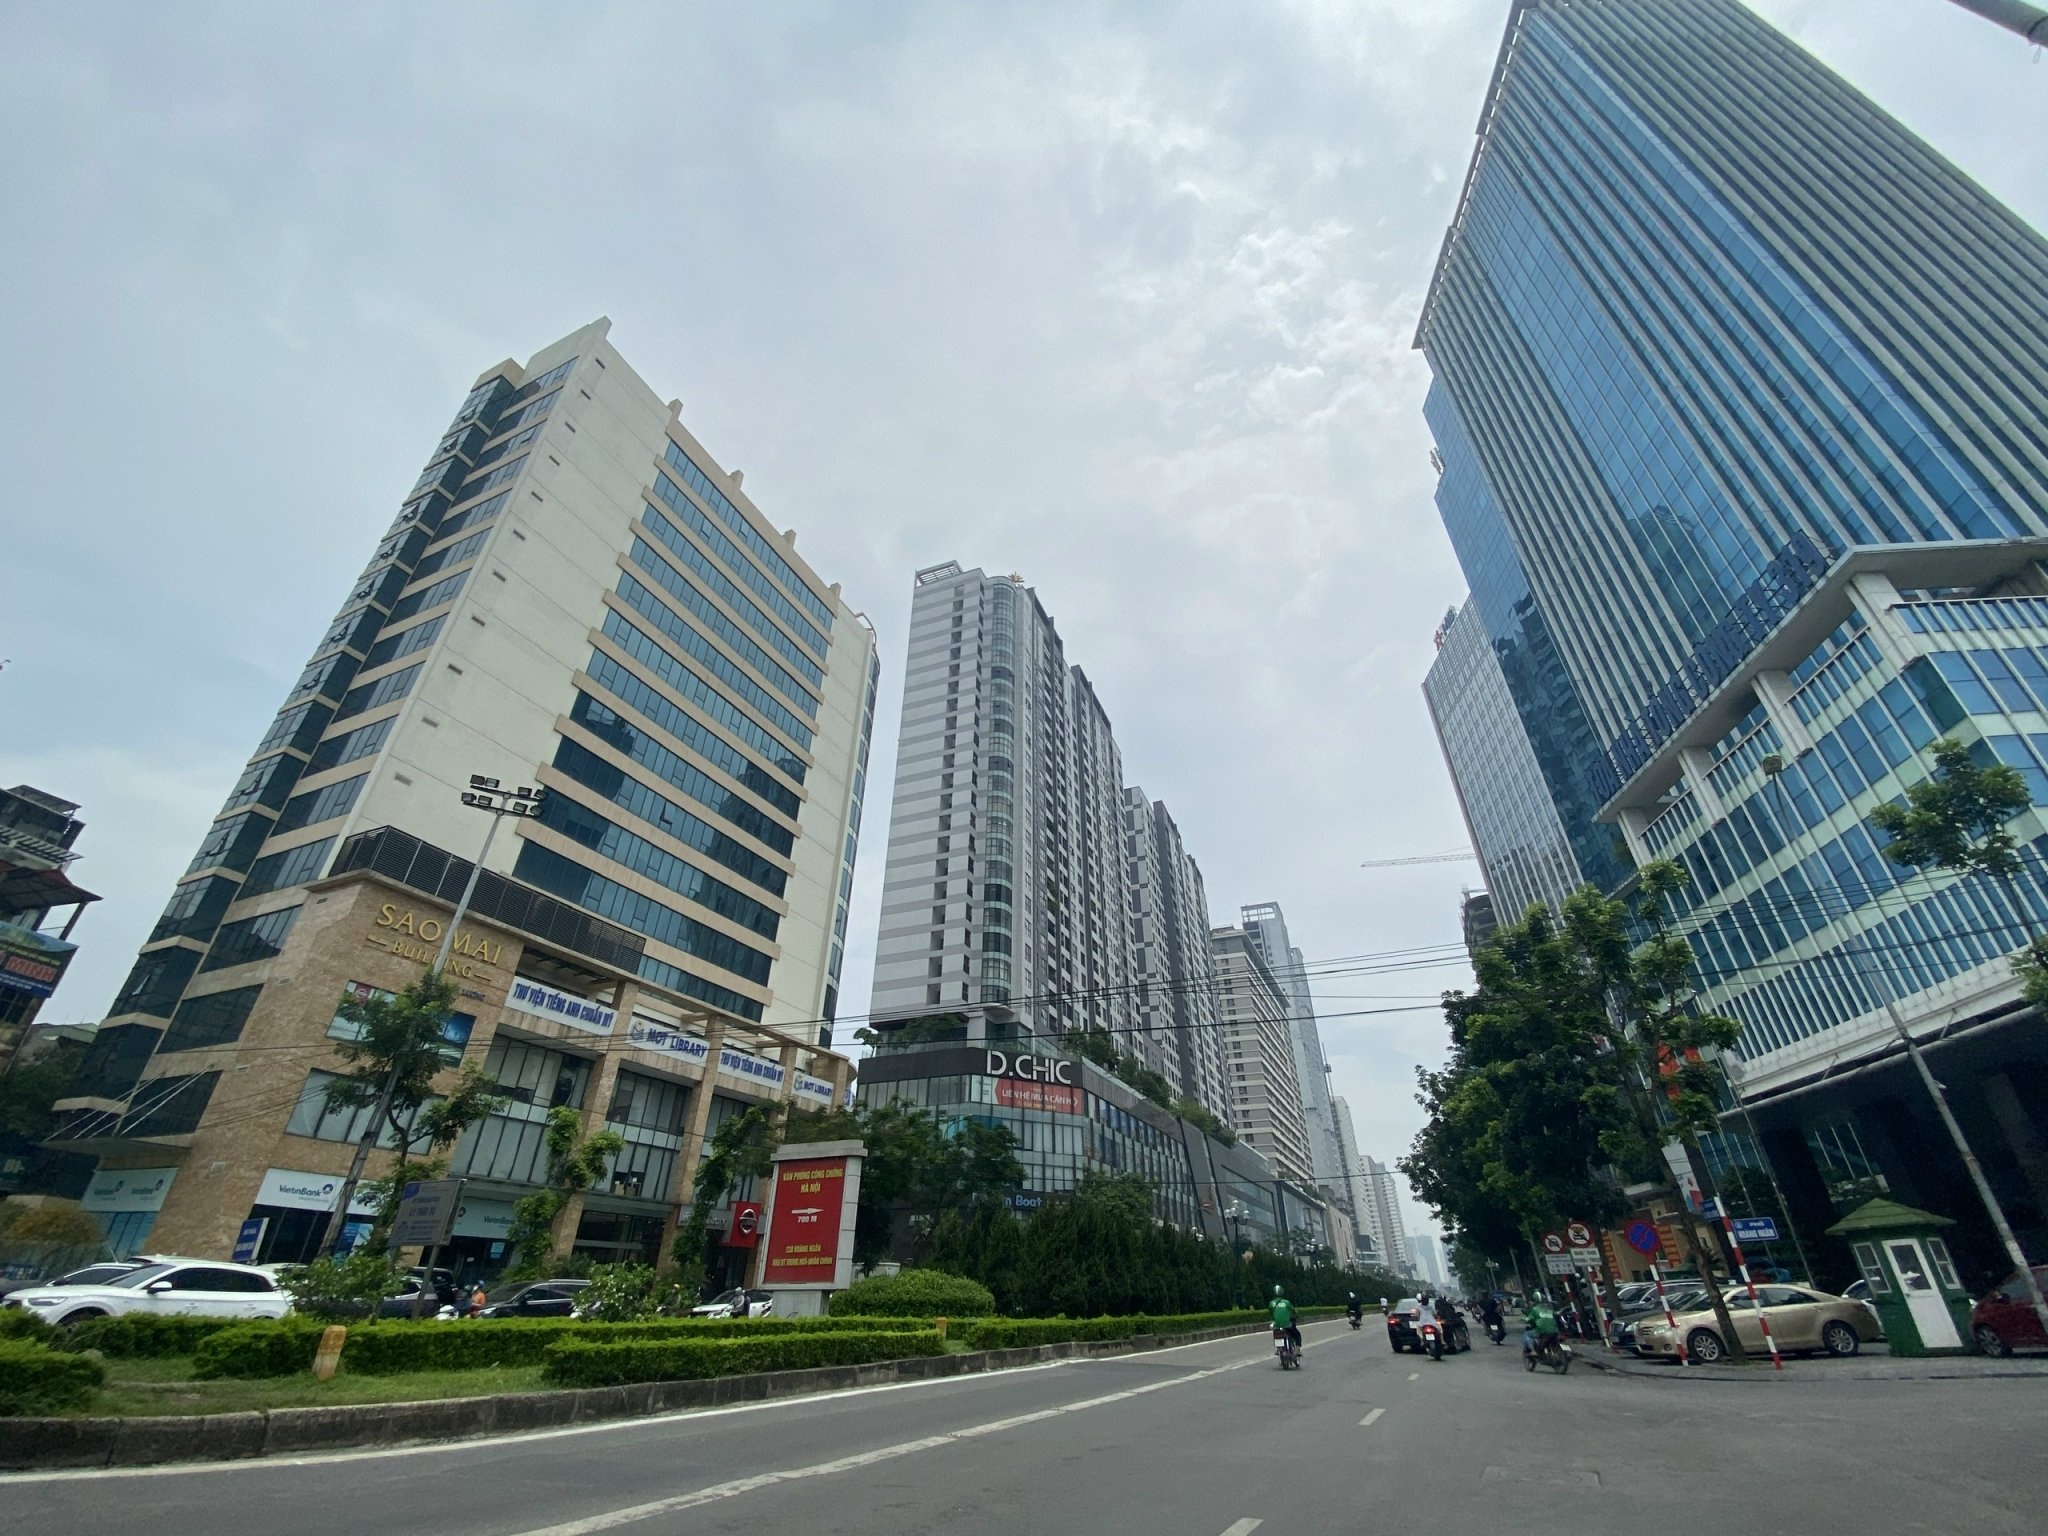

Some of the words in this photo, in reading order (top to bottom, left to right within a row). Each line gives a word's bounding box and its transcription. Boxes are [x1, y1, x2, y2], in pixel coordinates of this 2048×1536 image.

[376, 903, 442, 942] SAO
[452, 927, 502, 965] MAI
[513, 983, 531, 1001] THƯ
[528, 987, 547, 1008] VIỆN
[546, 991, 567, 1013] TIẾNG
[564, 1001, 582, 1018] ANH
[670, 1036, 708, 1058] LIBRARY
[986, 1049, 1072, 1085] D.CHIC
[279, 1184, 322, 1197] VietinBank
[1016, 1195, 1042, 1207] Boat
